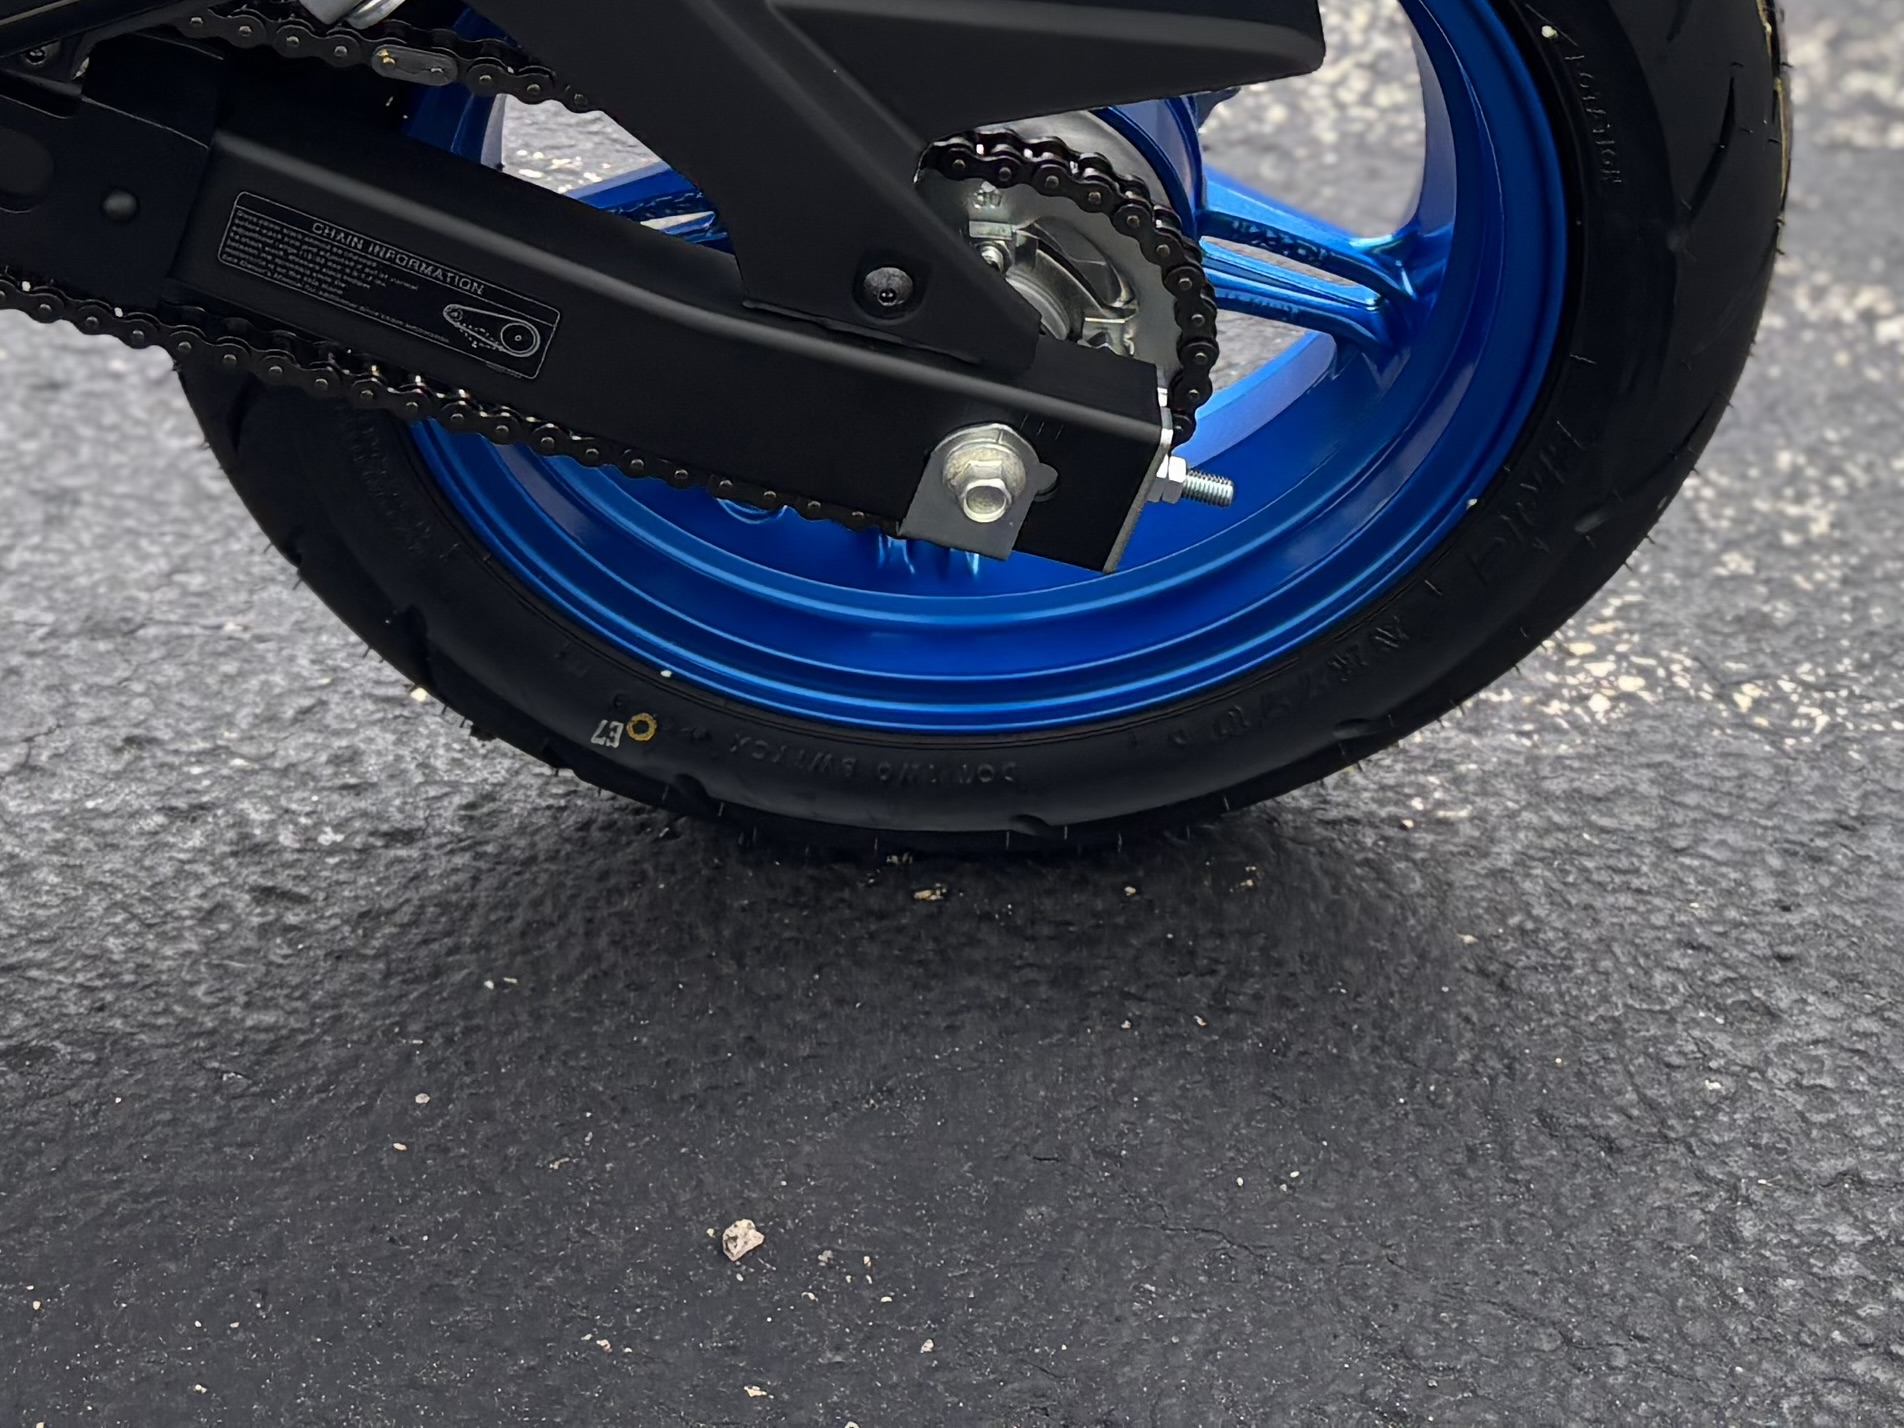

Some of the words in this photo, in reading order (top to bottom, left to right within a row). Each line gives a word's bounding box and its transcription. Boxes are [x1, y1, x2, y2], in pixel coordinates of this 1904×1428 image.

[312, 222, 364, 249] CHAIN
[368, 242, 485, 296] INFORMATION
[590, 718, 624, 750] E7
